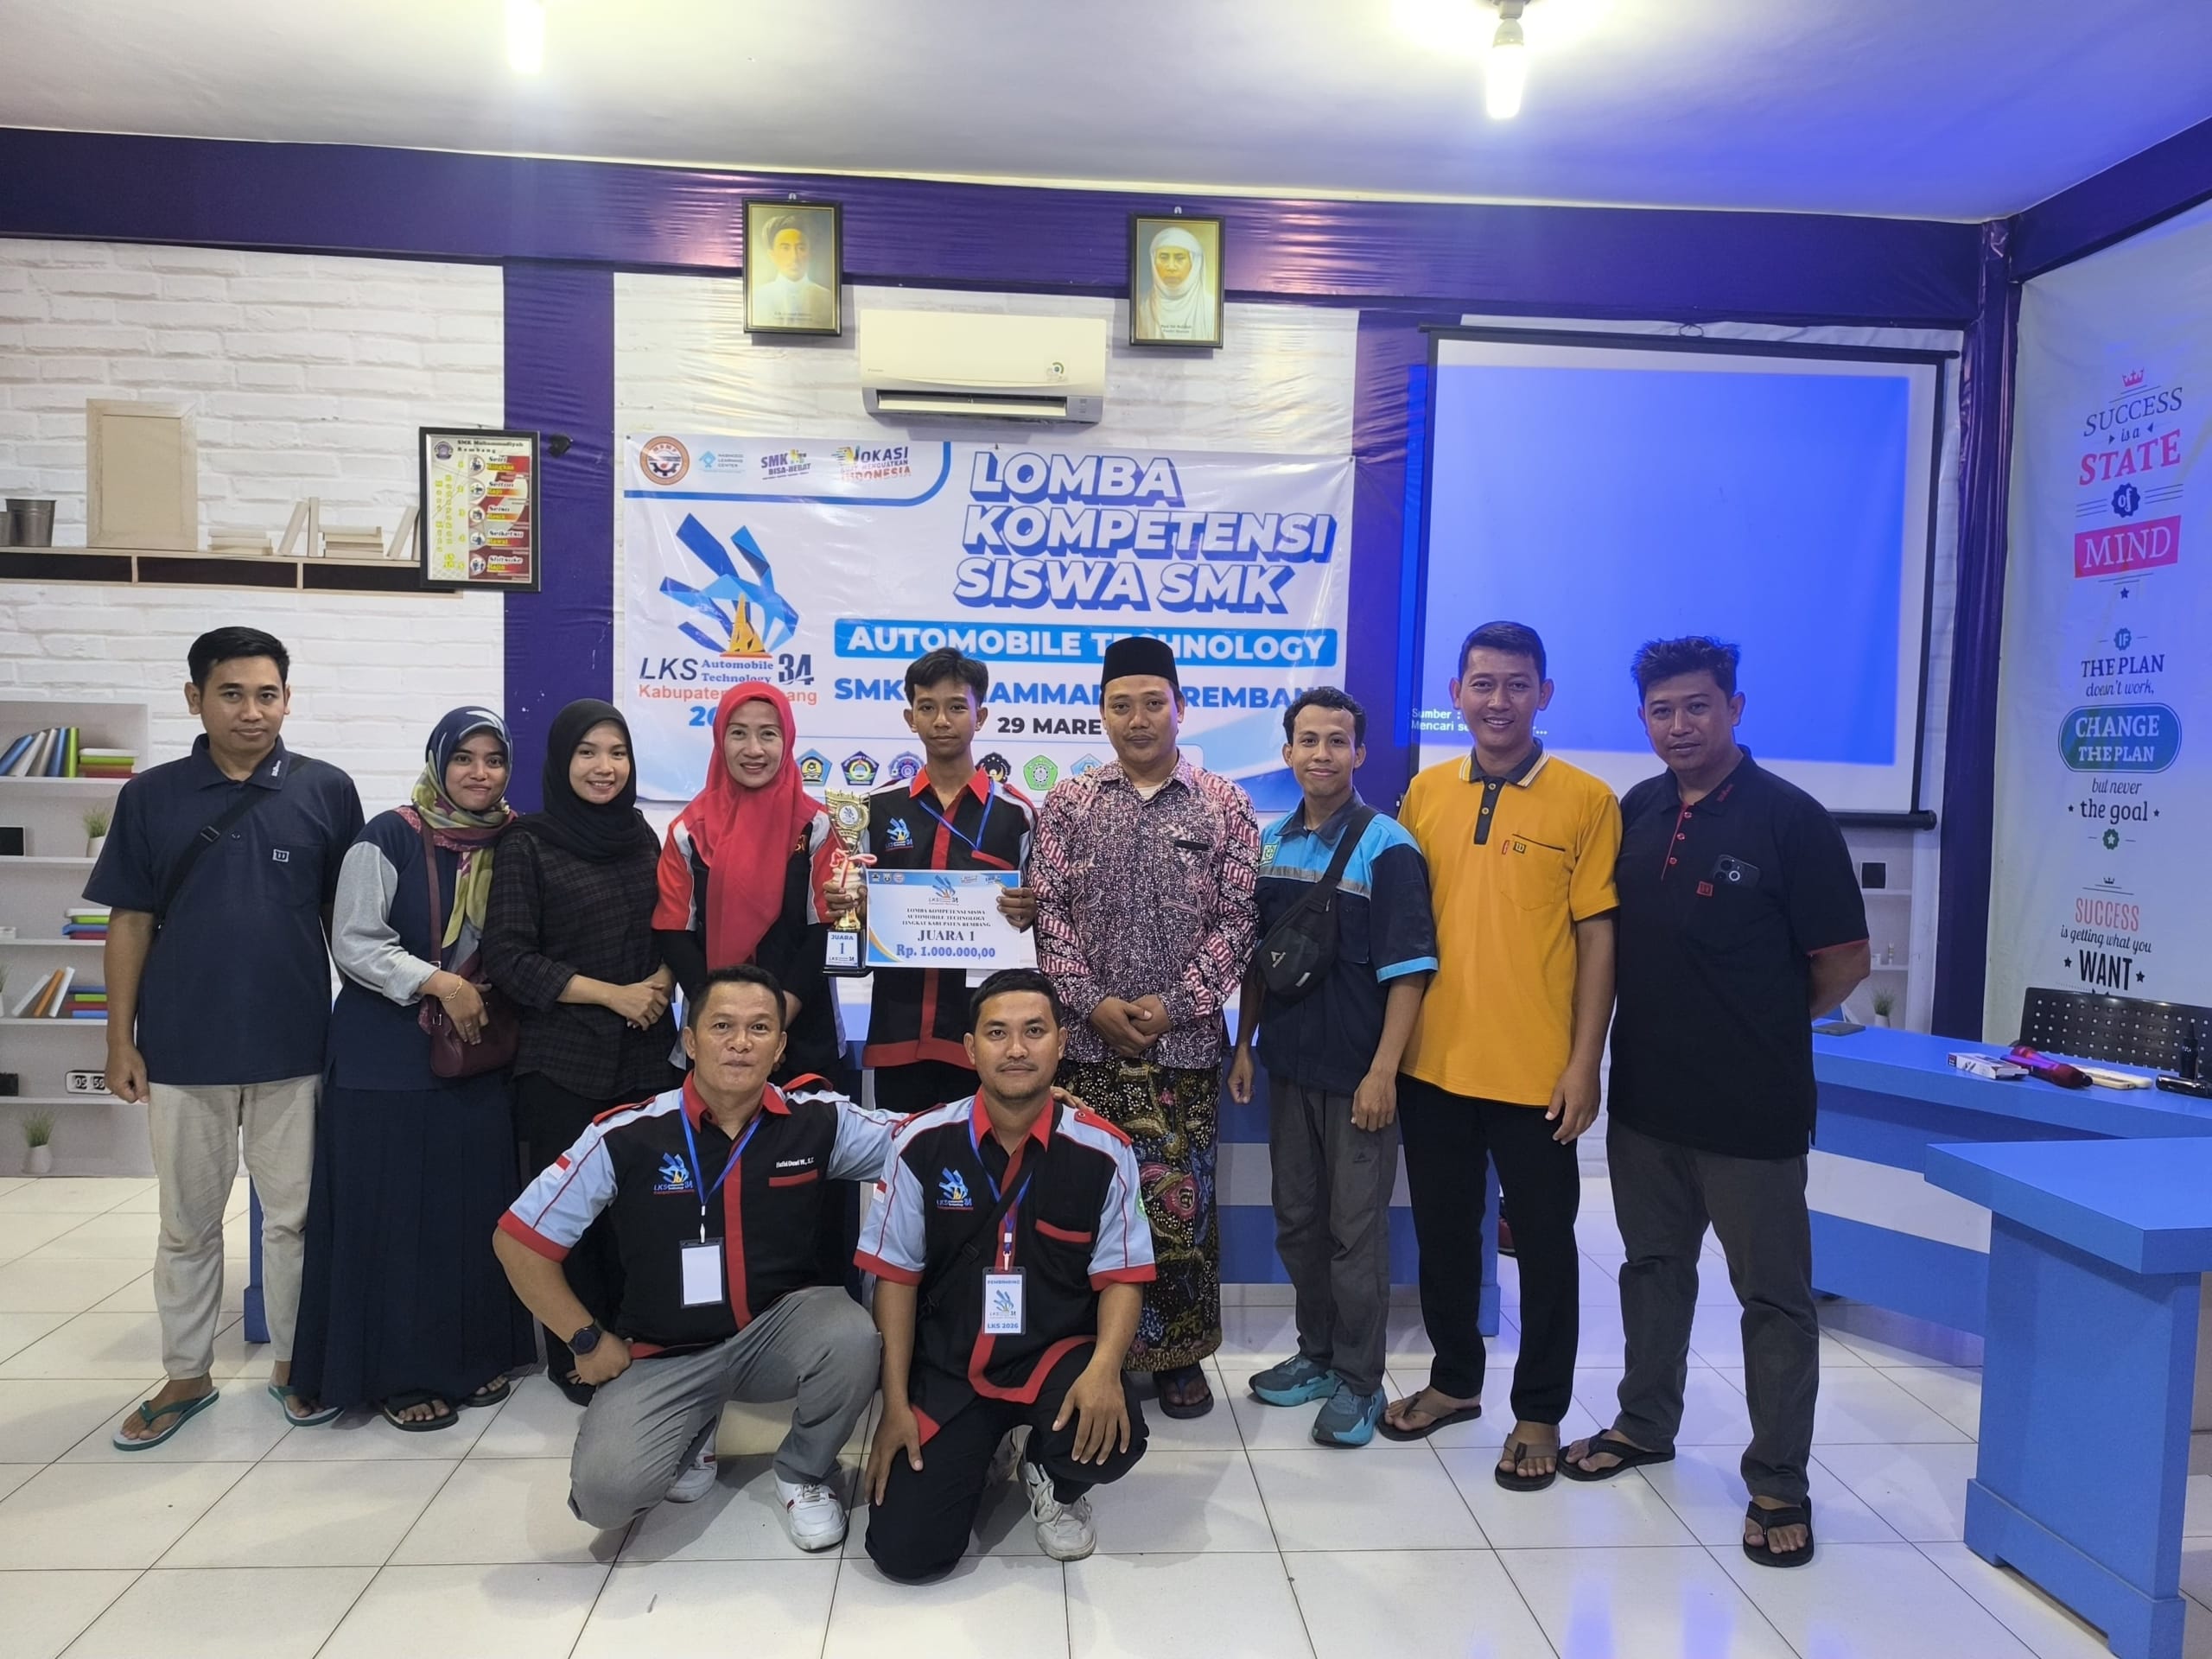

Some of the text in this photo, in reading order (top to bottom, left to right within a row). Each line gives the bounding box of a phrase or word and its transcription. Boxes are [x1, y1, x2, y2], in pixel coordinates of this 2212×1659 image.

[2083, 387, 2183, 436] SUCCESS
[2120, 428, 2139, 442] is a
[761, 453, 788, 468] SMK
[2079, 429, 2181, 486] STATE
[969, 451, 1185, 508] LOMBA
[2118, 488, 2133, 512] of
[963, 505, 1338, 563] KOMPETENSI
[2083, 526, 2171, 568] MIND
[953, 557, 1295, 614] SISWA SMK
[847, 626, 1325, 661] AUTOMOBILE THNOLOGY
[2118, 632, 2128, 648] IF
[639, 653, 814, 685] LKS Automobile 34
[2081, 654, 2164, 677] THE PLAN
[639, 684, 724, 702] Kabupate
[834, 677, 906, 701] SMK
[2086, 680, 2121, 696] doesn't
[997, 716, 1103, 734] 29 MARE
[1412, 709, 1452, 719] Sumber
[1411, 721, 1454, 731] Mencari
[2075, 715, 2159, 738] CHANGE
[2079, 746, 2155, 762] THE PLAN
[2092, 778, 2142, 795] but never
[2081, 798, 2148, 824] the goal
[2075, 898, 2139, 931] SUCCESS
[918, 930, 975, 941] JUARA 1
[2061, 924, 2152, 955] is getting what you
[896, 944, 995, 959] Rp. 1.000.000,00
[2080, 949, 2133, 991] WANT
